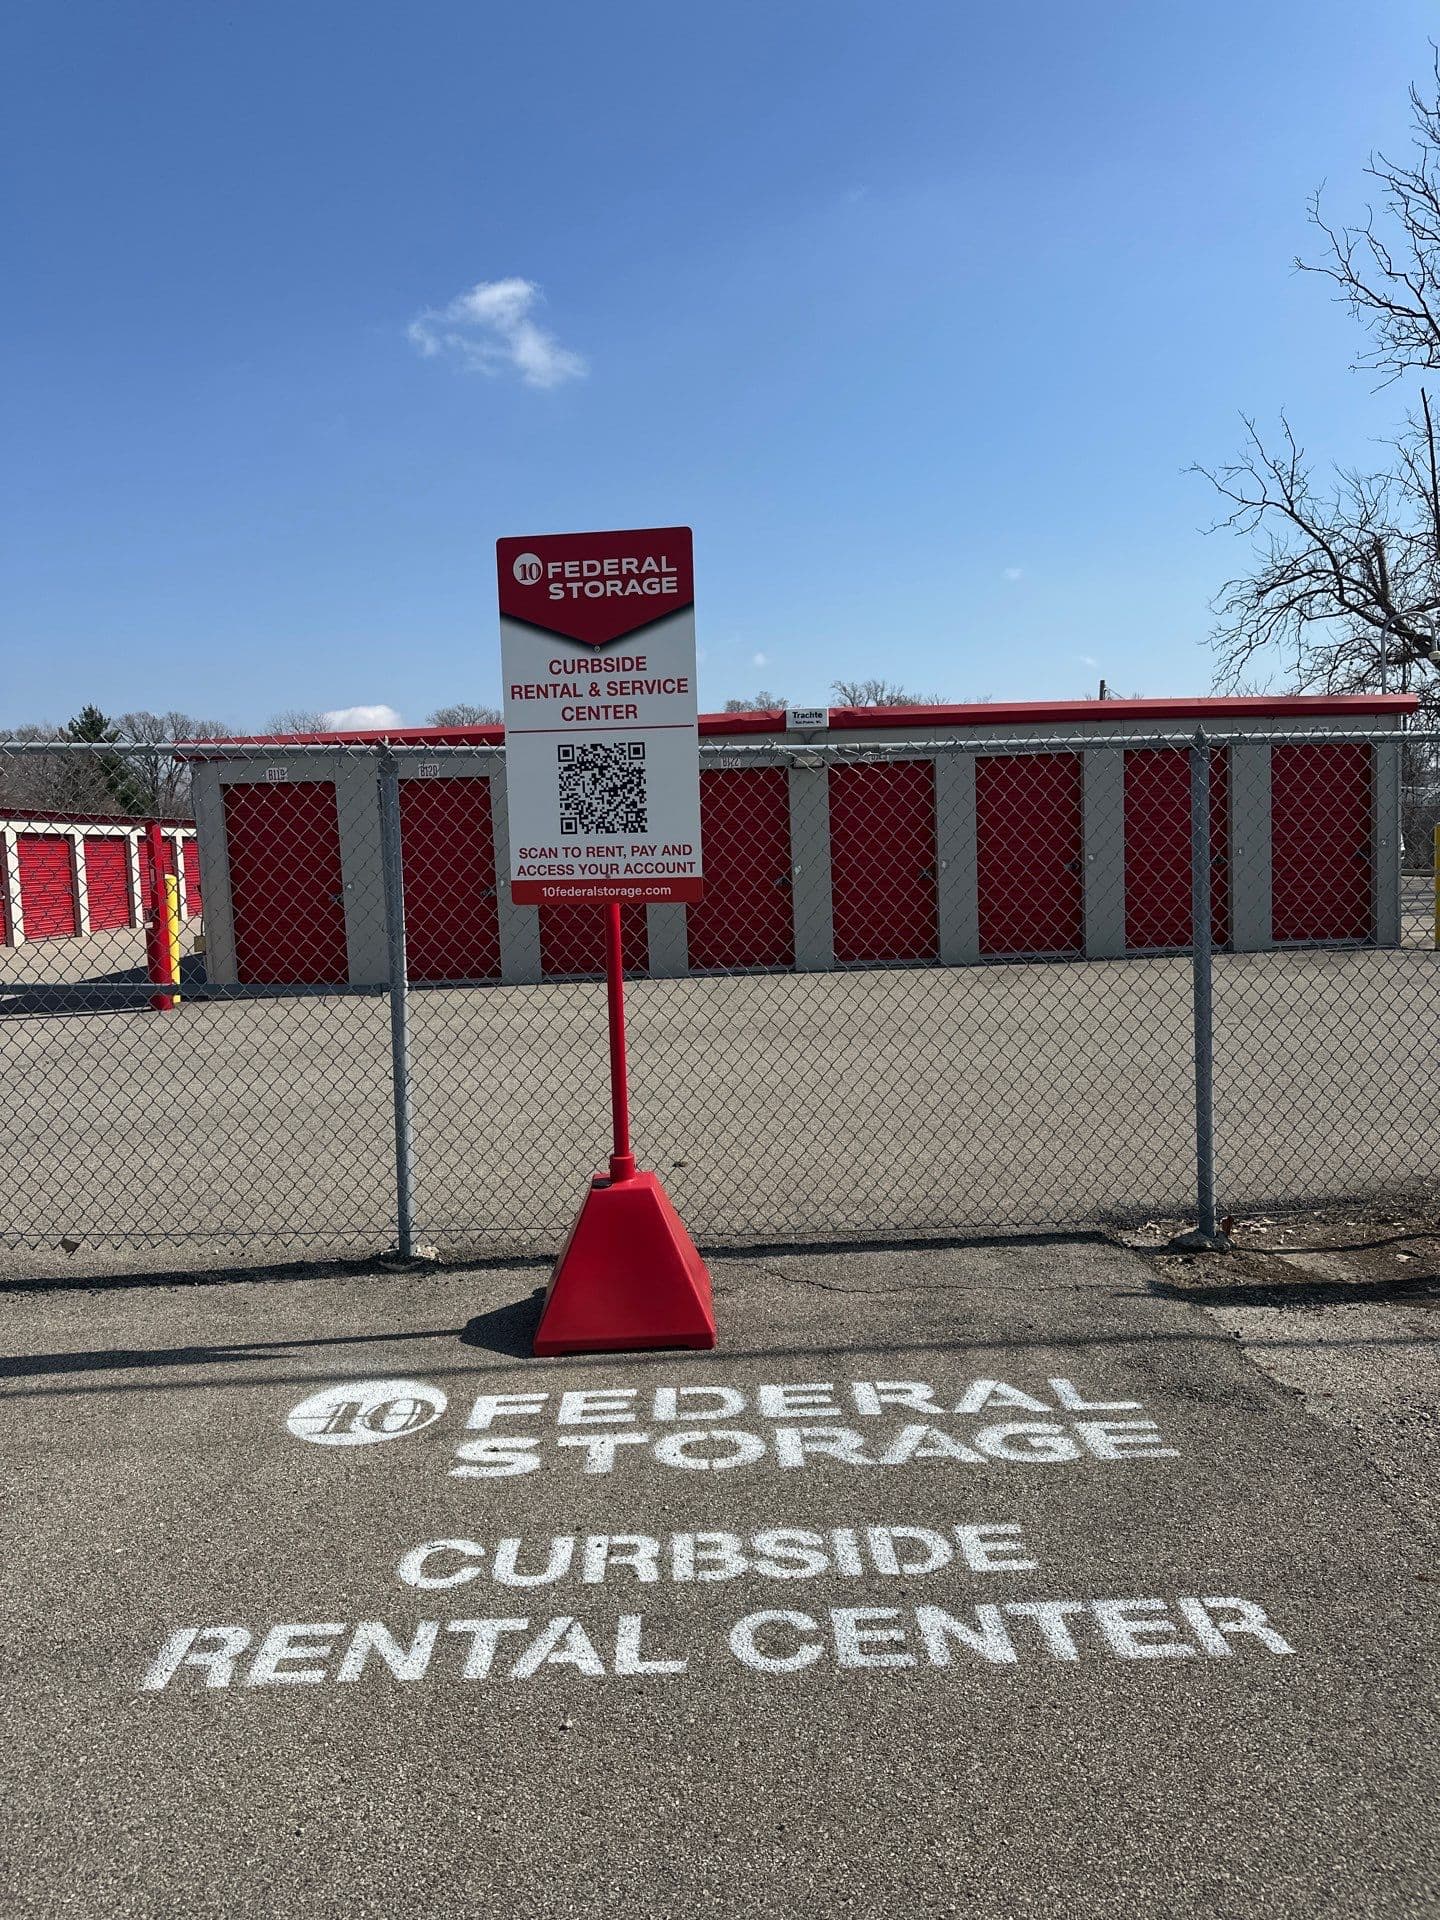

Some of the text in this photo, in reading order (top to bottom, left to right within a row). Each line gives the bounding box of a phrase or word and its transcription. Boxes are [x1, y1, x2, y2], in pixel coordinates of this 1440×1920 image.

[547, 556, 677, 578] FEDERAL
[549, 576, 678, 600] STORAGE
[549, 656, 647, 675] CURBSIDE
[511, 678, 688, 700] RENTAL & SERVICE
[561, 704, 638, 722] CENTER
[792, 711, 823, 719] Trachte
[519, 844, 693, 859] SCAN TO RENT, PAY AND
[517, 862, 696, 876] ACCESS YOUR ACCOUNT
[542, 885, 672, 898] 10federalstorage.com
[464, 1377, 1142, 1431] FEDERAL
[447, 1420, 1181, 1478] STORAGE
[398, 1523, 1039, 1590] CURBSIDE
[140, 1595, 1298, 1692] RENTAL CENTER
